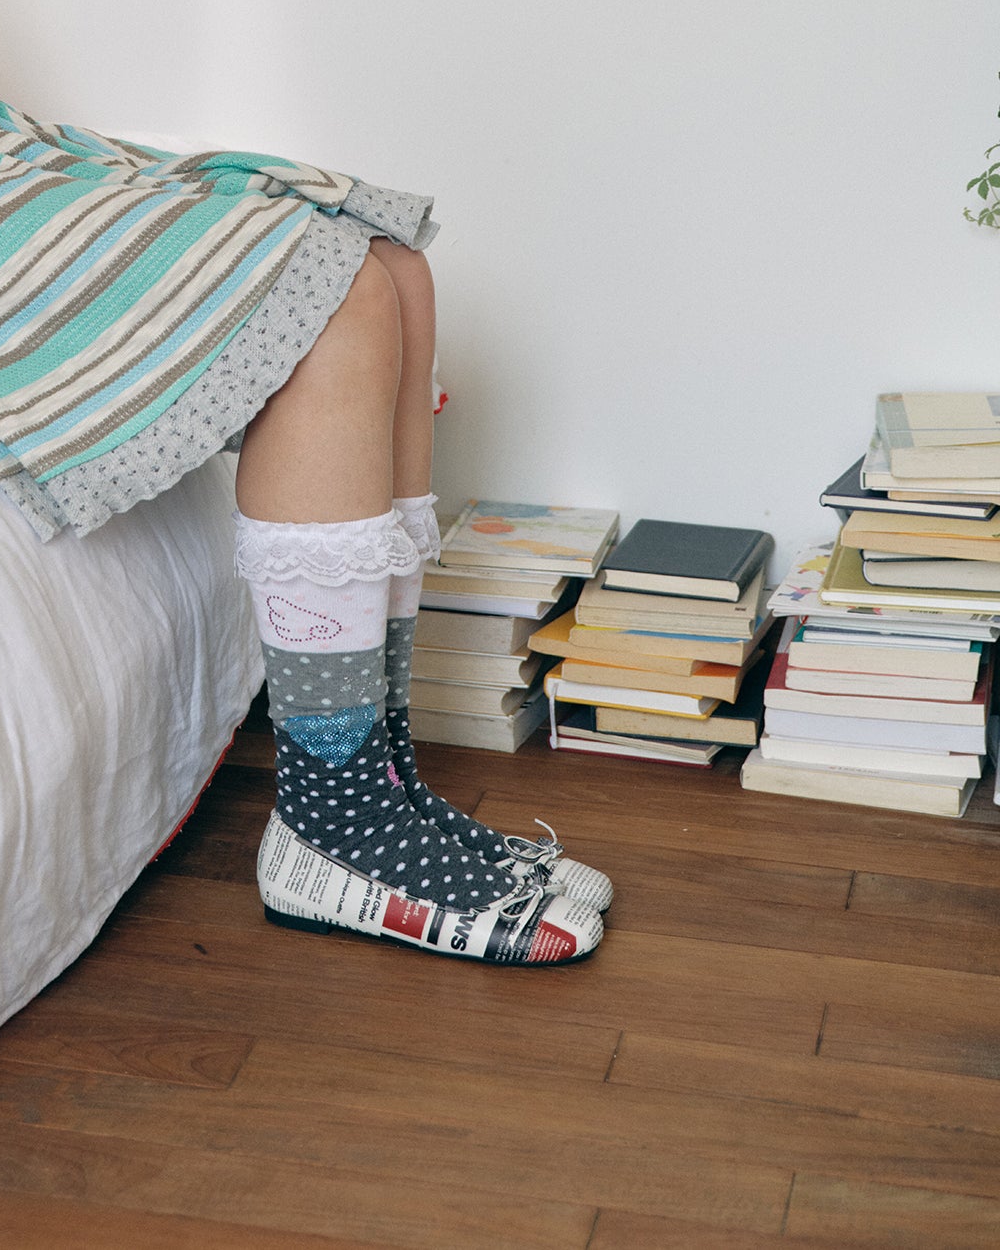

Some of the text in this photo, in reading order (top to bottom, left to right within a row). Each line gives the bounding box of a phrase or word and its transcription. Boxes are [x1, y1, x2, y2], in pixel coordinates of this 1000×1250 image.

[342, 877, 351, 896] Unique
[358, 898, 369, 922] British
[369, 900, 379, 921] Glow
